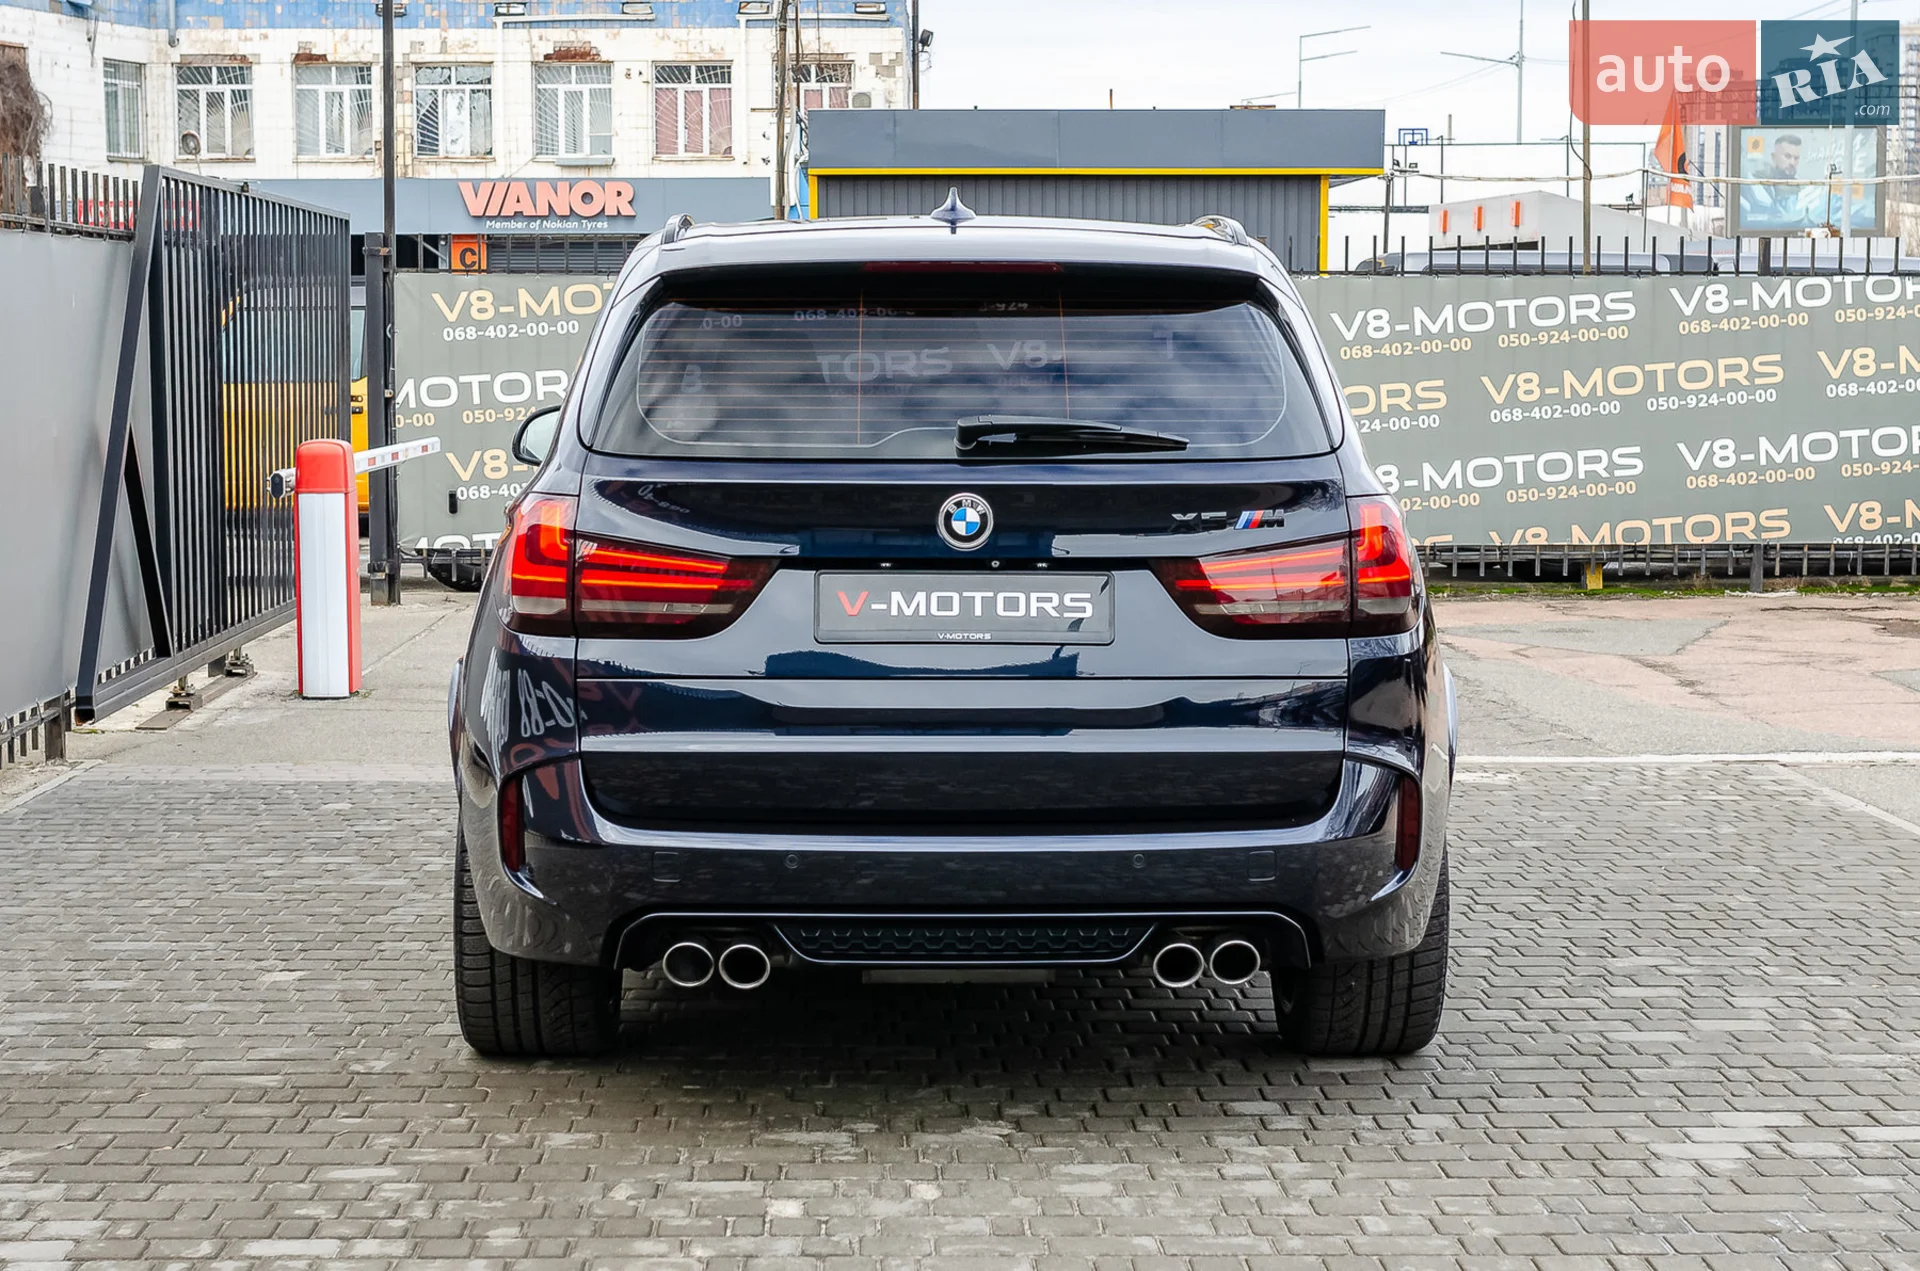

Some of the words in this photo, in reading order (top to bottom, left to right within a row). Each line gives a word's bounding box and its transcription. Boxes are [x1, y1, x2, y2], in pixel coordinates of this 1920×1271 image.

[458, 180, 636, 217] VIANOR
[486, 220, 527, 229] Member
[529, 220, 540, 230] of
[543, 220, 578, 229] Nokian
[581, 220, 609, 230] Tyres
[443, 320, 580, 342] 068-402-00-00
[1330, 290, 1636, 342] V8-MOTORS
[1679, 312, 1809, 335] 068-402-00-00
[1340, 337, 1472, 360] 068-402-00-00
[1498, 325, 1630, 348] 050-924-00-00
[1480, 354, 1785, 406] V8-MOTORS
[1355, 413, 1440, 433] 24-00-00
[1490, 399, 1621, 423] 068-402-00-00
[1646, 387, 1777, 412] 050-924-00-00
[1676, 424, 1920, 472] V8-MOTO
[445, 448, 538, 482] V8-
[1685, 466, 1816, 489] 068-402-00-00
[947, 499, 986, 515] BMW
[1506, 480, 1637, 503] 050-924-00-00
[837, 591, 1093, 619] V-MOTORS
